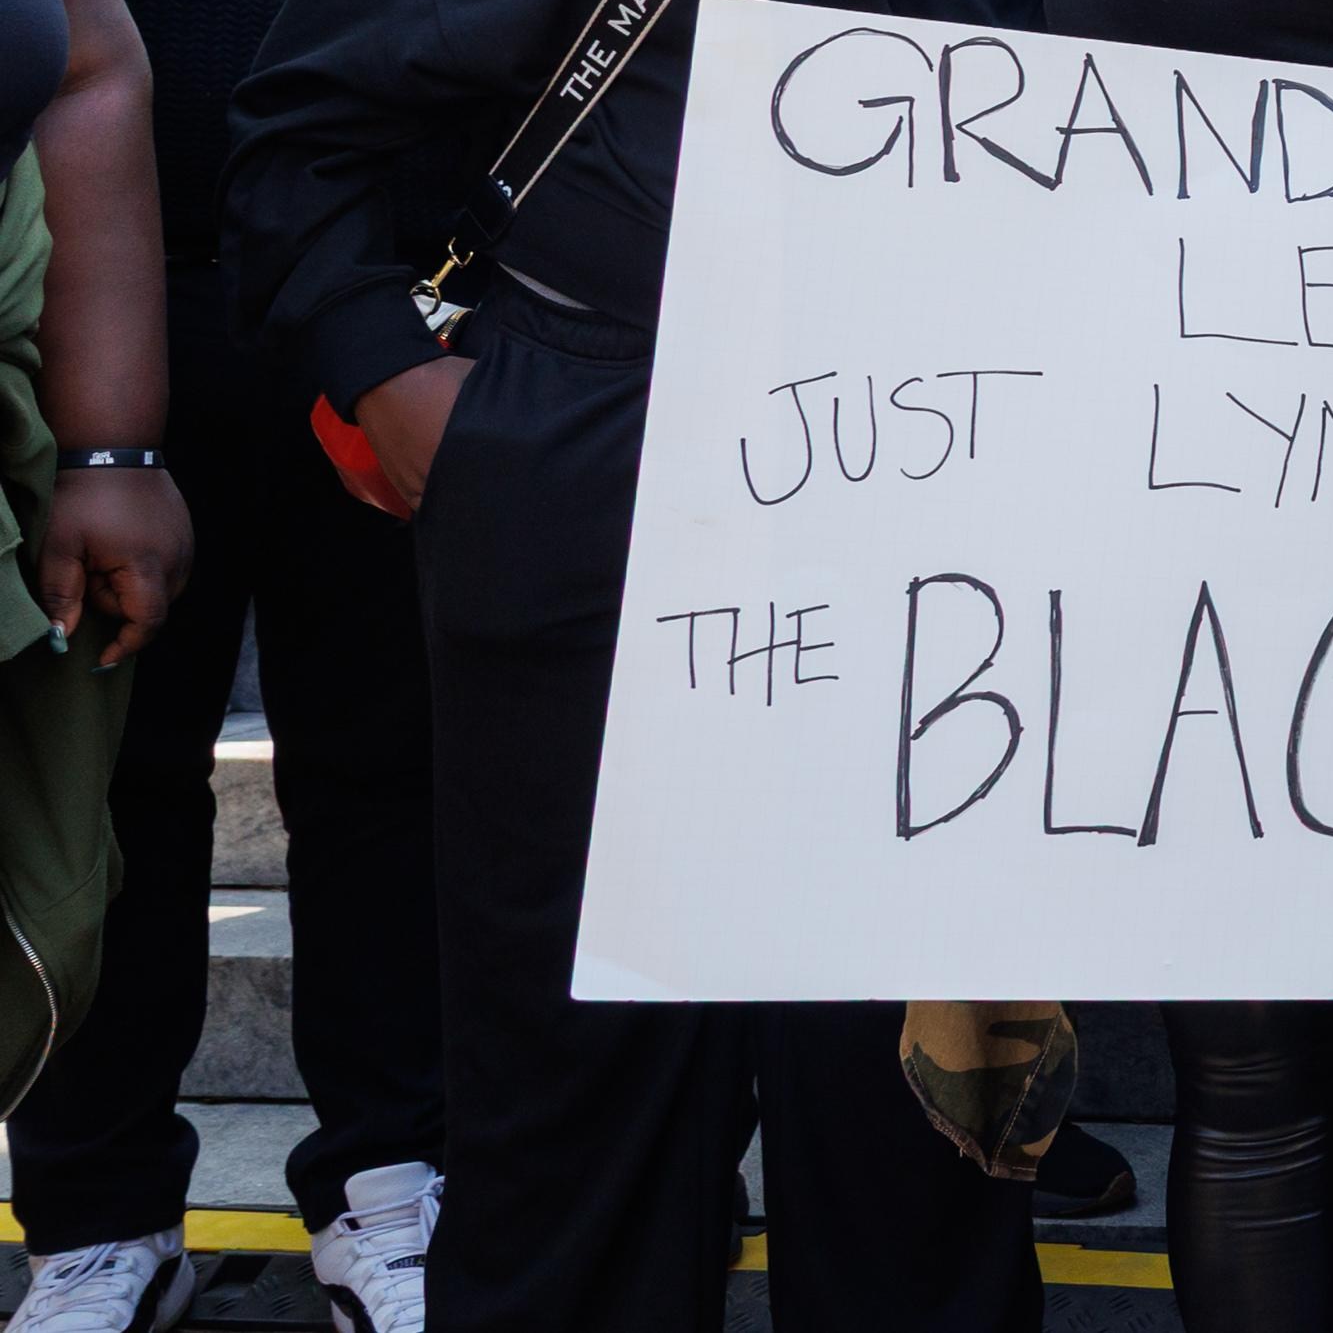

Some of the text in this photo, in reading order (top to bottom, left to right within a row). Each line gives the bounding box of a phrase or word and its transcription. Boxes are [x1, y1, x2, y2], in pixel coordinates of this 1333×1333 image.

[560, 40, 617, 102] THE
[740, 370, 1044, 506] JUST
[656, 602, 840, 707] THE
